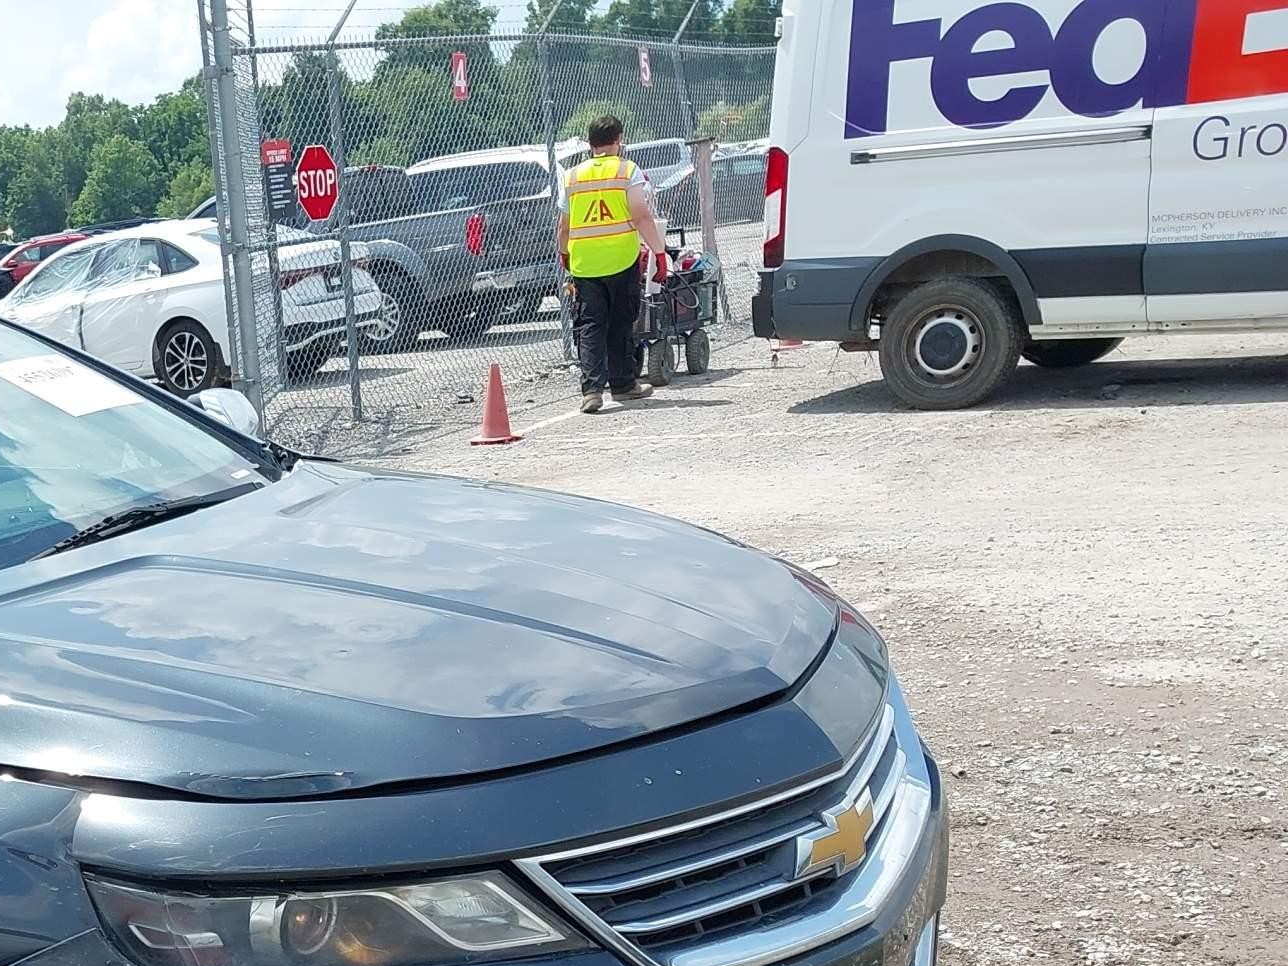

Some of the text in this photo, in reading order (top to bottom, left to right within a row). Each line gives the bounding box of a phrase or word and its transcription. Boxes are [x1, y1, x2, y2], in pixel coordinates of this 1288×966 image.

[456, 59, 466, 93] 4
[641, 52, 649, 81] 5
[300, 169, 335, 198] STOP
[1152, 212, 1214, 222] MCPHERSON
[1217, 208, 1265, 219] DELIVERY
[1200, 231, 1236, 241] Service
[1237, 229, 1277, 239] Provider
[1201, 222, 1216, 230] KY
